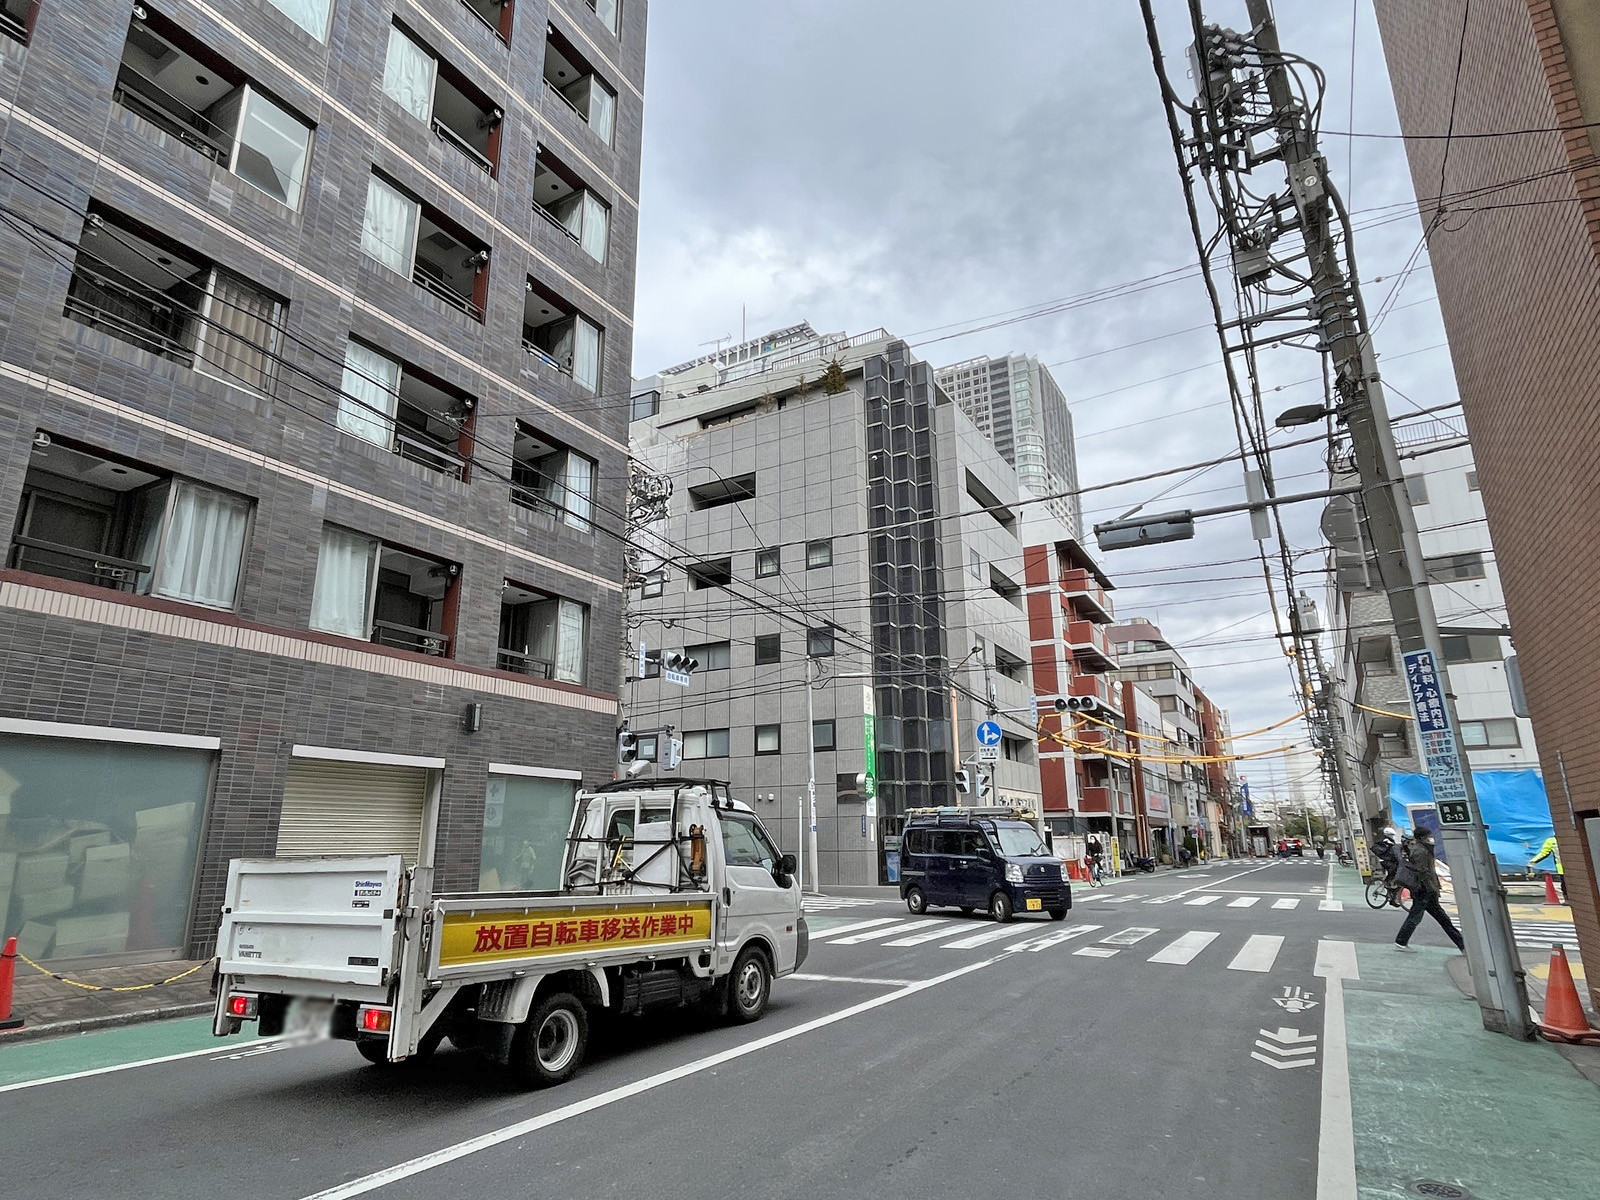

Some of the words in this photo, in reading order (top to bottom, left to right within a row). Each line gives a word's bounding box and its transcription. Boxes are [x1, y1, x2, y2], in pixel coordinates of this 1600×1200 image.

[1446, 813, 1465, 821] 2-13
[473, 914, 694, 953] 放置自転車移送作業中
